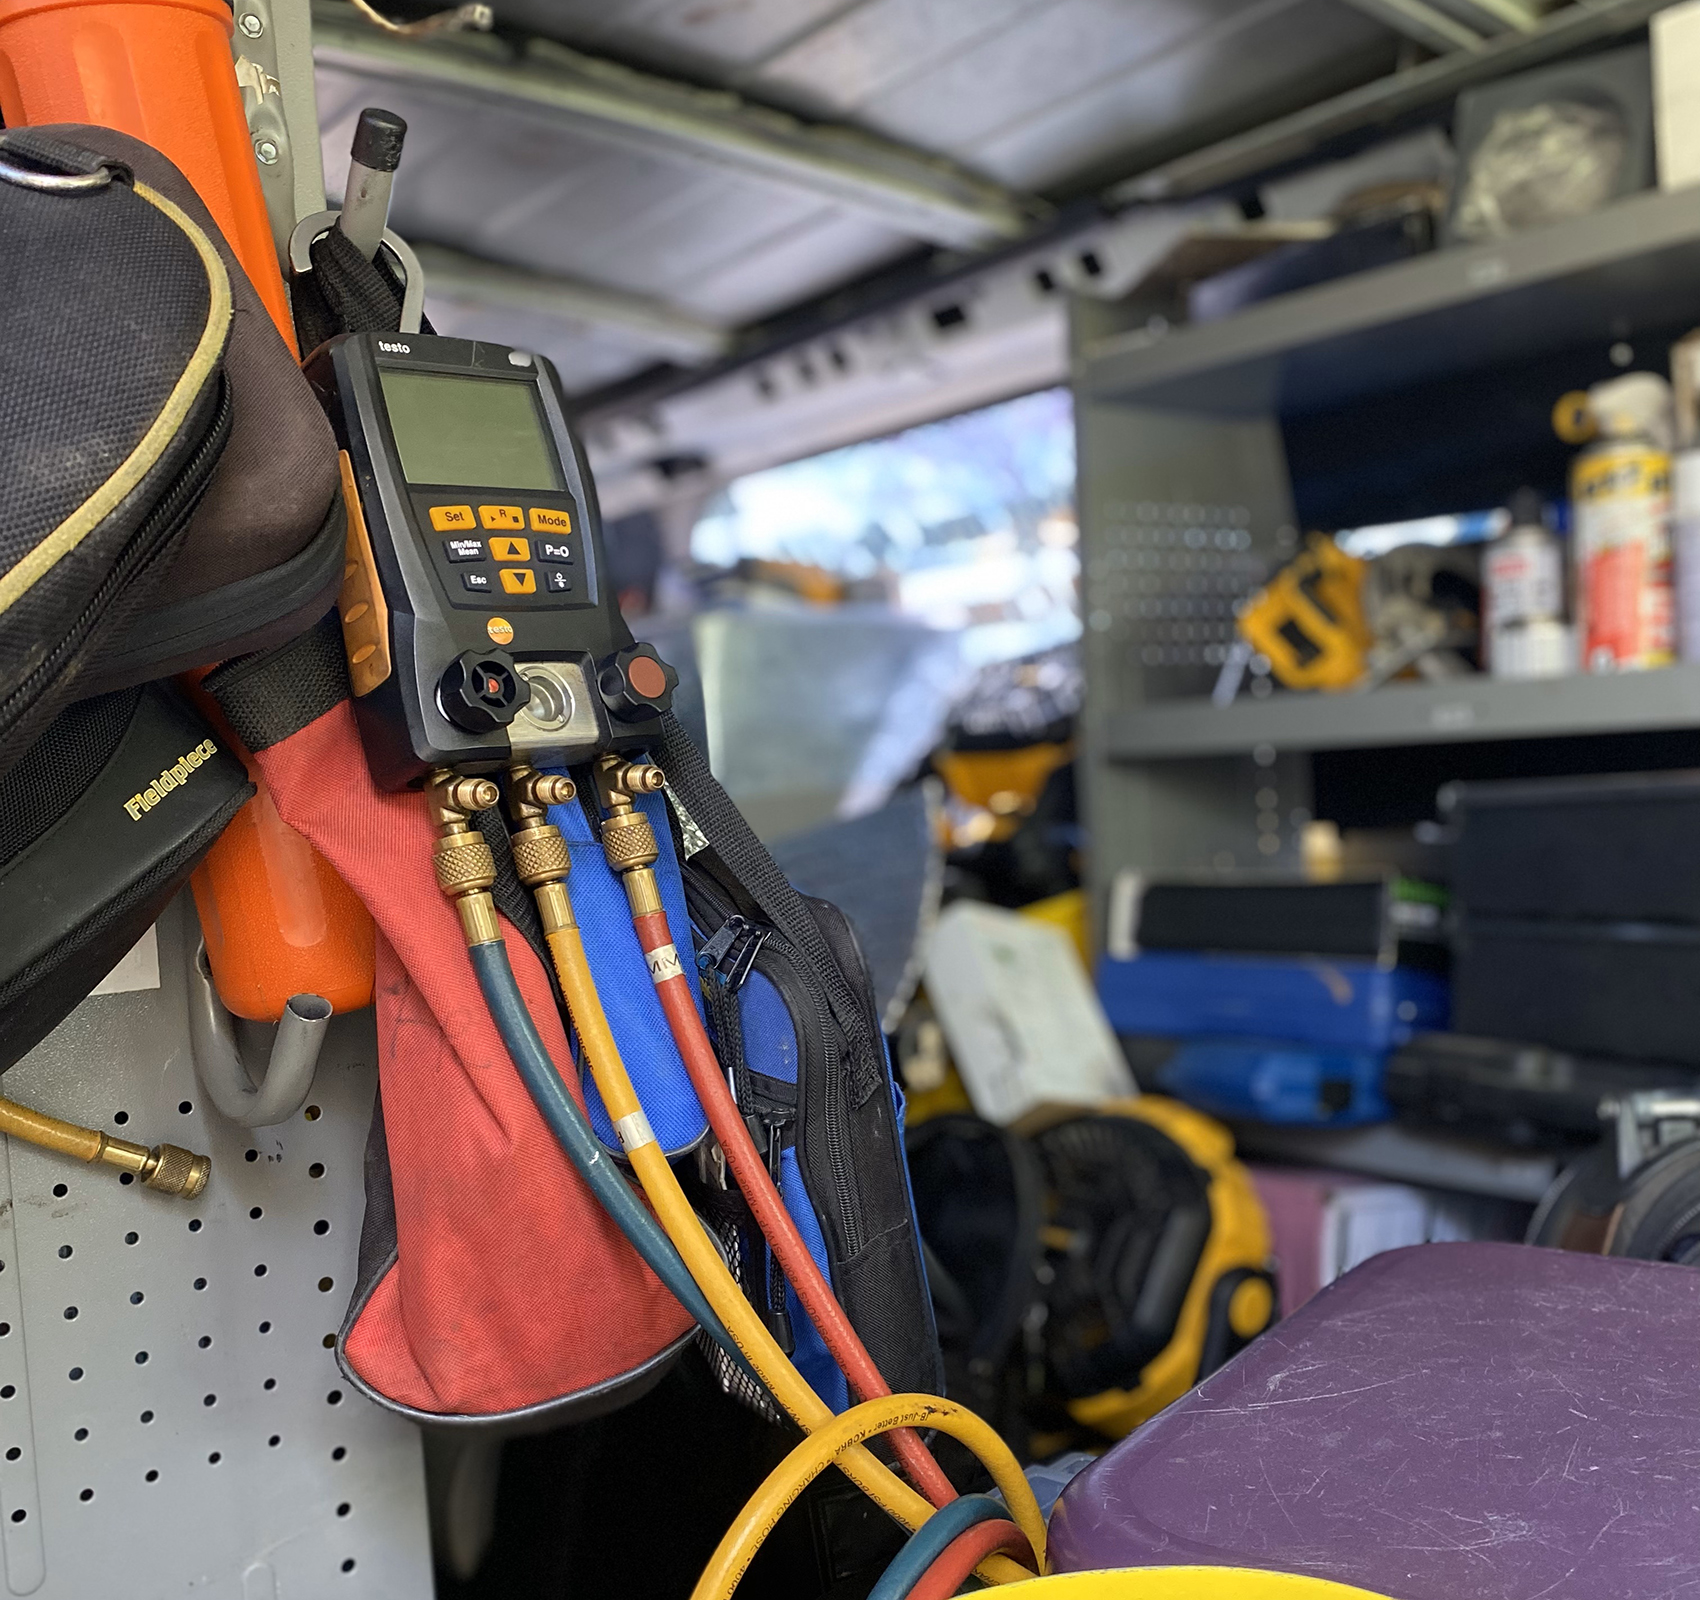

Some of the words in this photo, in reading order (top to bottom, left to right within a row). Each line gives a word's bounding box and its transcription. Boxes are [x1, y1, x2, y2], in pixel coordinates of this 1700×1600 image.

[378, 340, 411, 354] testo
[444, 511, 465, 522] Set
[499, 508, 507, 518] R
[537, 514, 567, 527] Mode
[449, 540, 482, 550] Min/Max
[458, 547, 479, 556] Mean
[469, 575, 487, 584] Esc
[123, 738, 218, 821] Fieldpiece
[721, 1139, 737, 1164] USA
[740, 1179, 758, 1208] Made
[753, 1363, 776, 1391] Made
[776, 1461, 825, 1516] CHARGING
[750, 1517, 776, 1552] HOSE
